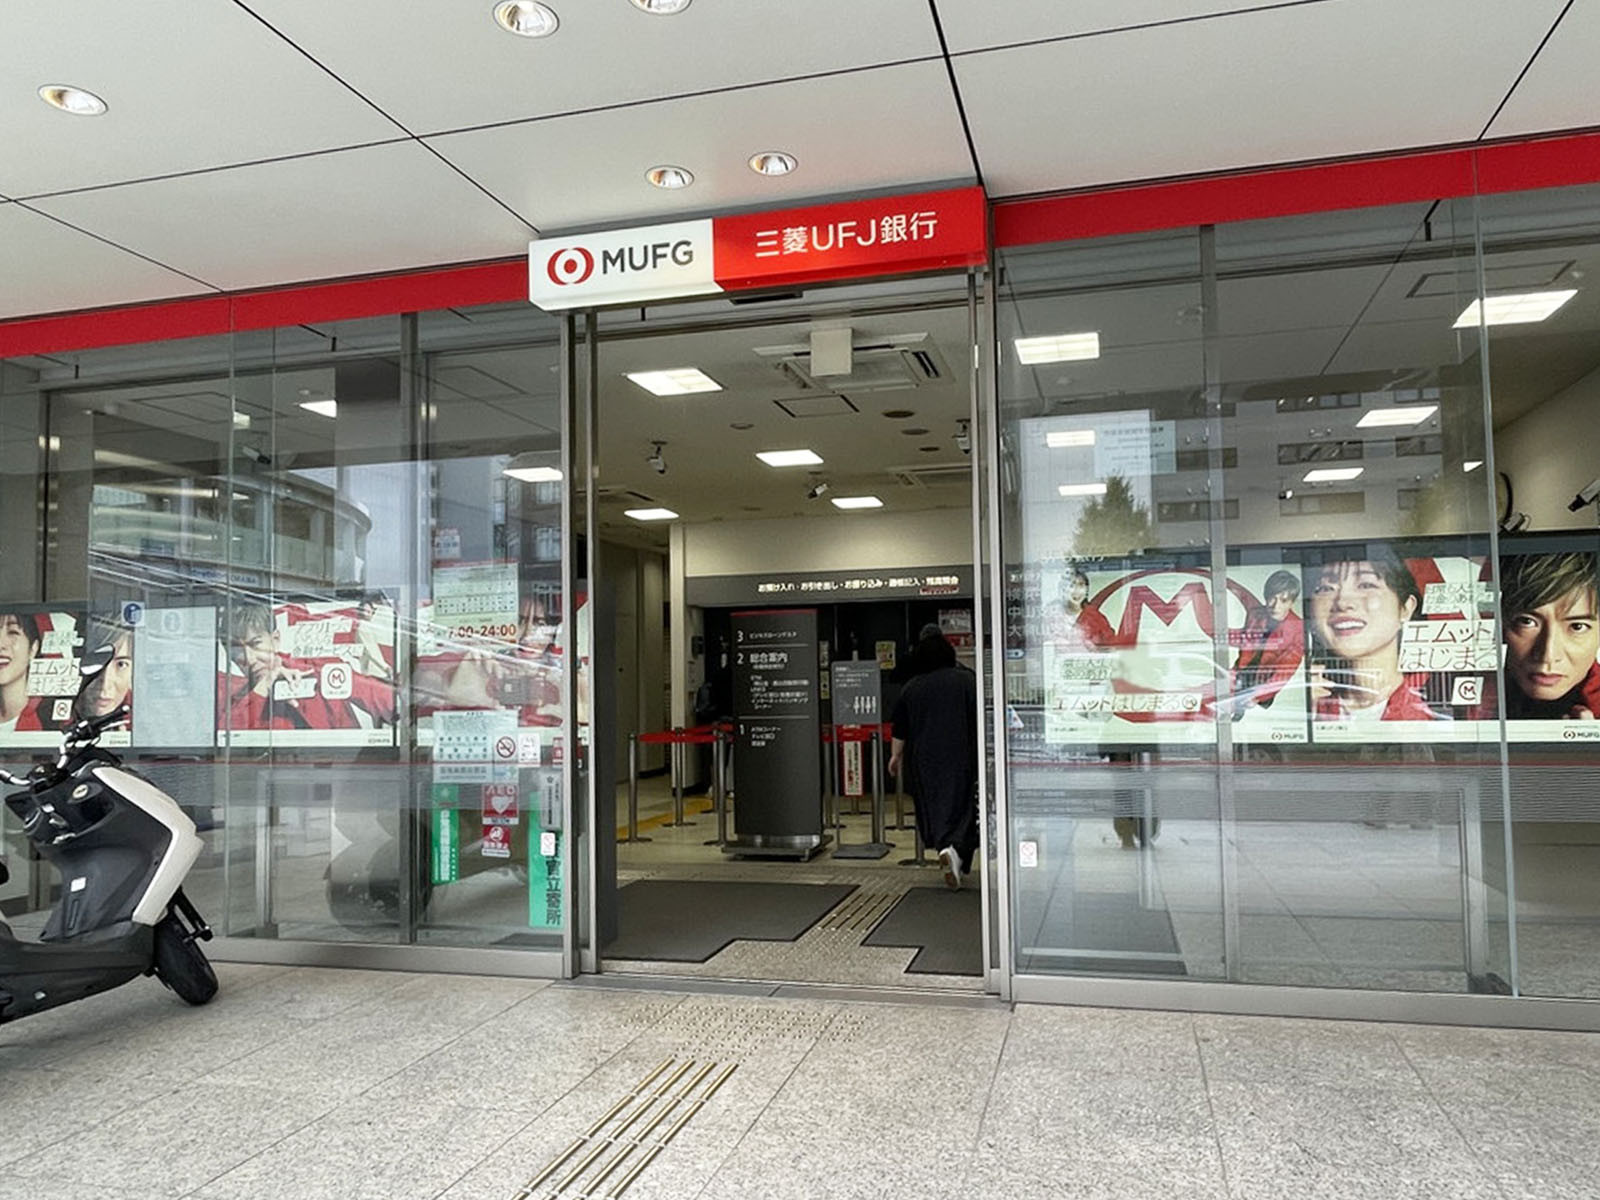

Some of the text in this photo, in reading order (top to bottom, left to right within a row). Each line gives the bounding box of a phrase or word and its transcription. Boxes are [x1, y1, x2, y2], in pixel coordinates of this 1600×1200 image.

[754, 211, 938, 258] 三菱UFJ銀行
[602, 240, 694, 276] MUFG
[1403, 622, 1496, 644] エムット
[1401, 647, 1496, 670] はじまる
